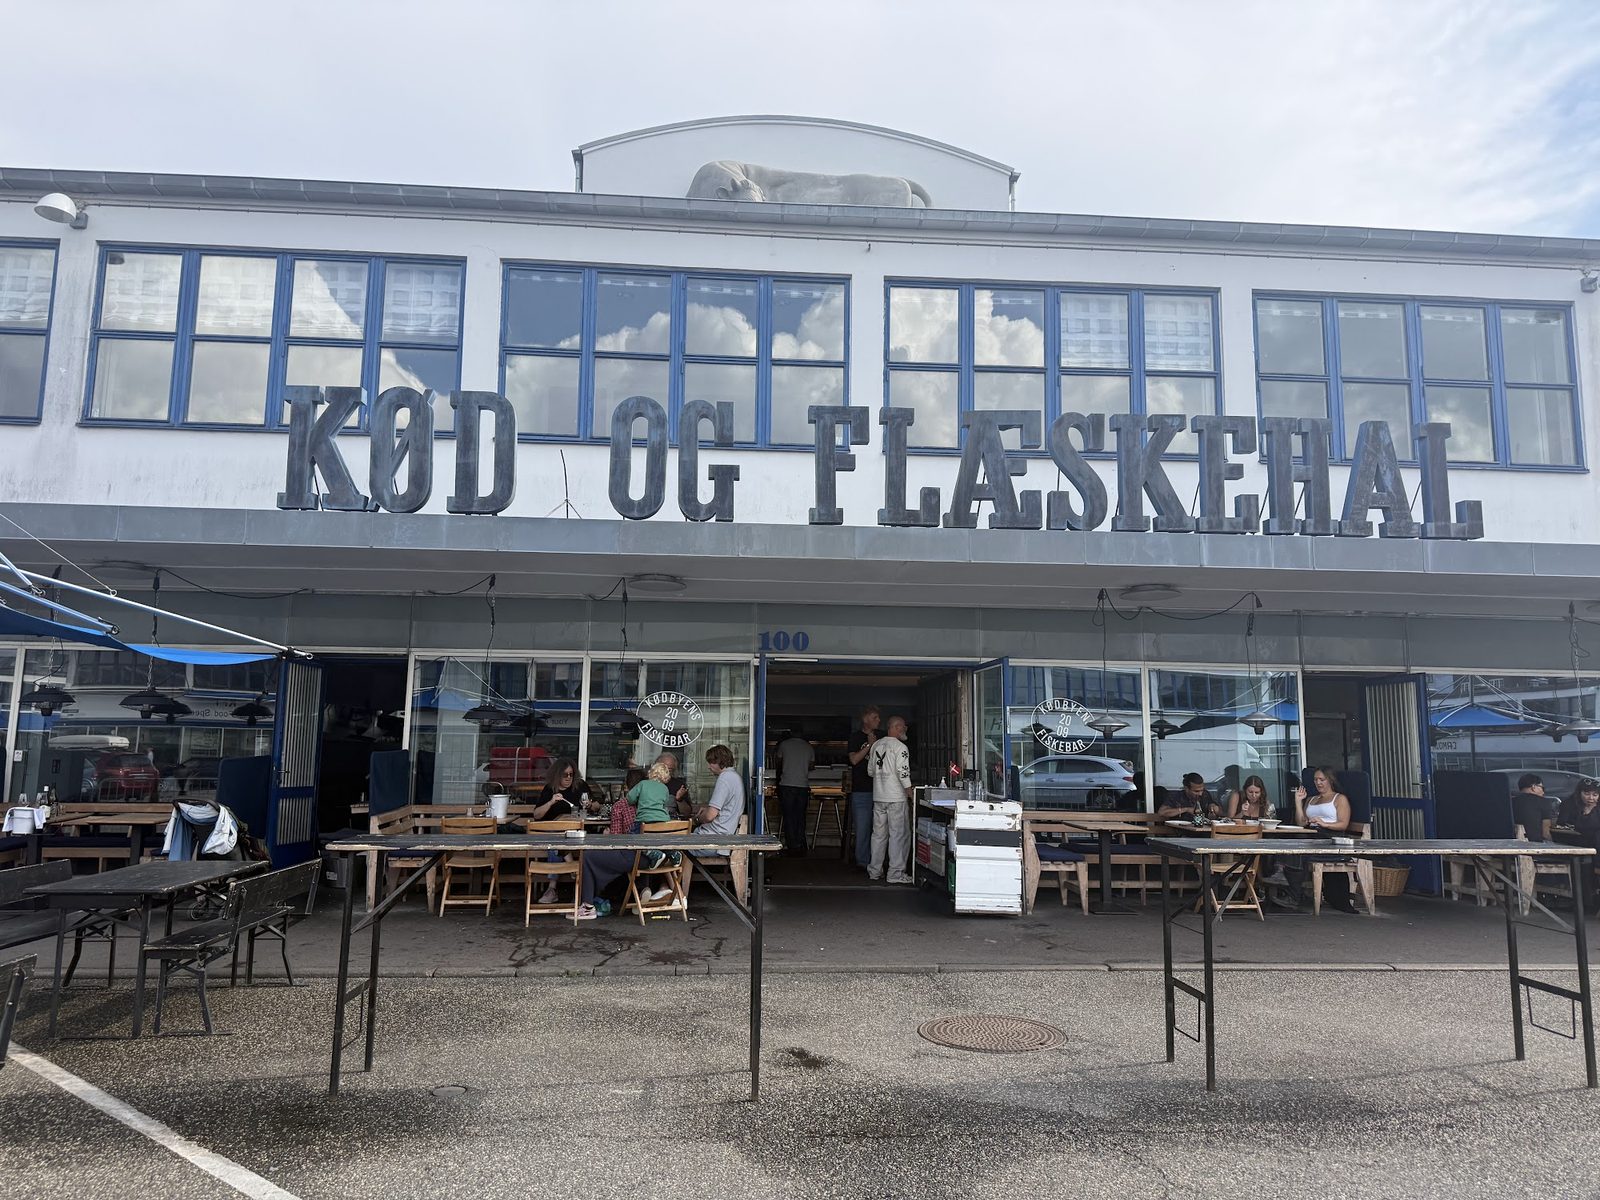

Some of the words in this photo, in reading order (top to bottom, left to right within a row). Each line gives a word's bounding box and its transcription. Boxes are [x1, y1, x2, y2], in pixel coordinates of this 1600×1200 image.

[277, 385, 517, 514] KØD
[608, 395, 740, 522] OG
[808, 405, 1485, 541] FLÆSKEHAL
[758, 630, 810, 652] 100
[645, 692, 702, 721] KØDBYENS
[665, 706, 679, 720] 20
[661, 718, 675, 732] 09
[1059, 713, 1072, 726] 20
[641, 722, 692, 746] FISKEBAR
[1037, 728, 1086, 752] FISKEBAR
[1056, 725, 1069, 738] 09
